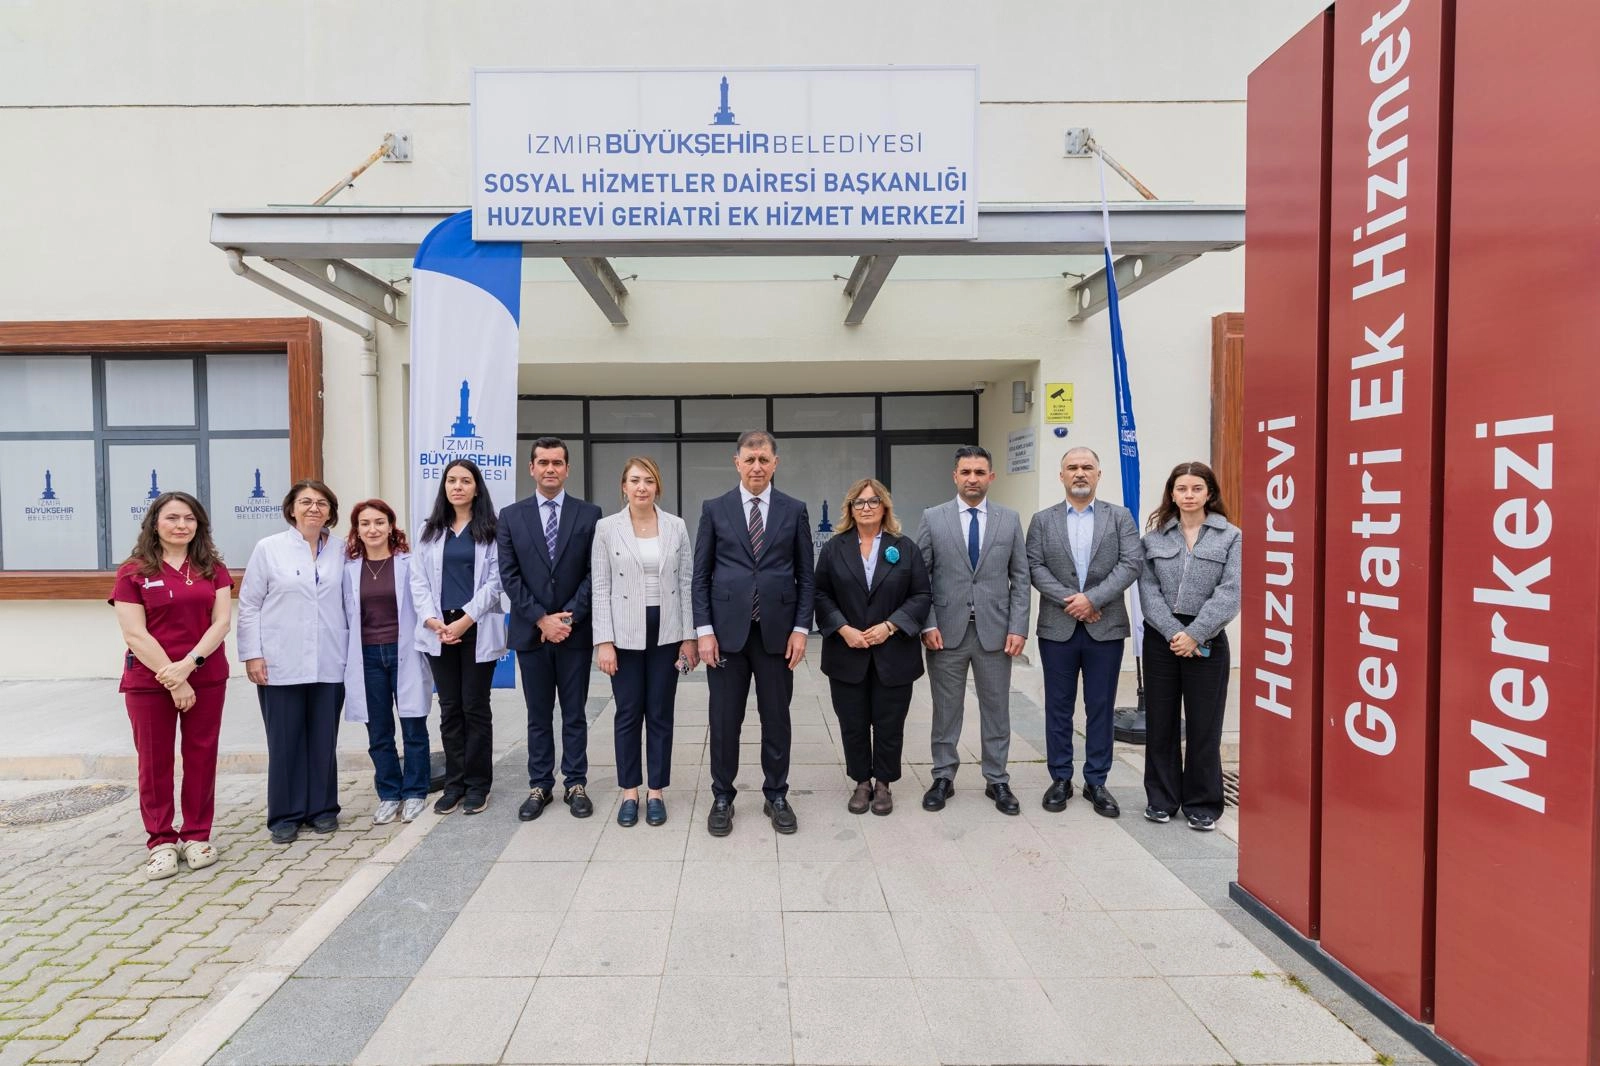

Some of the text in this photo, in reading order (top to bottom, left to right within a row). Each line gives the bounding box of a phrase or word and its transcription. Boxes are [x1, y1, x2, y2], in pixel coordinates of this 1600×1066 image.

[484, 166, 968, 196] SOSYAL HİZMETLER DAİRESİ BAŞKANLIĞI
[487, 199, 966, 227] HUZUREVİ GERİATRİ EK HİZMET MERKEZİ
[442, 438, 484, 451] İZMİR
[1345, 0, 1411, 756] Geriatri Ek Hizmet
[1255, 415, 1297, 719] Huzurevi
[1469, 414, 1554, 813] Merkezi
